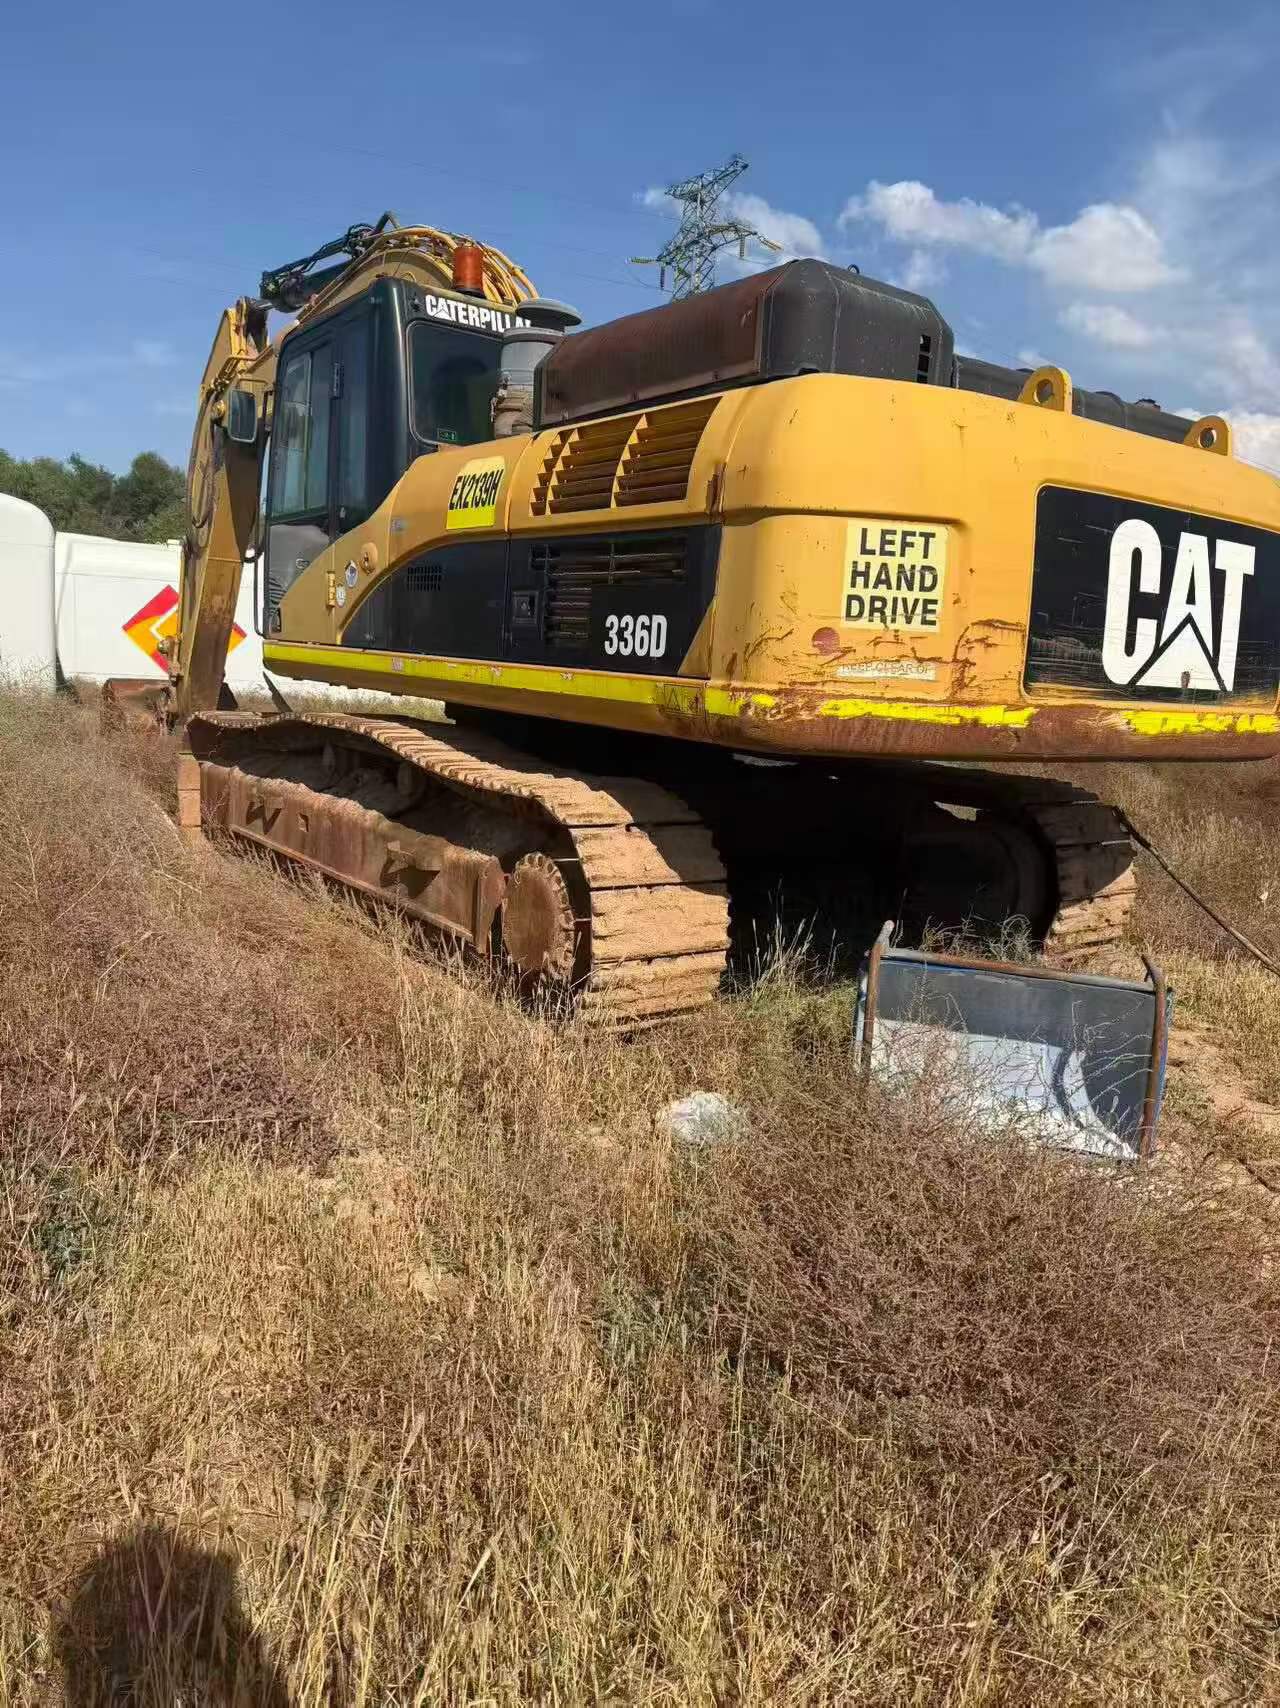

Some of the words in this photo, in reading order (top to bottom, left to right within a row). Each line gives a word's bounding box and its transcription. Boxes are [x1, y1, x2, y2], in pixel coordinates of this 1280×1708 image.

[448, 468, 504, 510] EX2139H
[859, 527, 936, 559] LEFT
[850, 560, 938, 593] HAND
[844, 594, 938, 627] DRIVE
[1102, 518, 1256, 692] CAT
[604, 614, 668, 658] 336D
